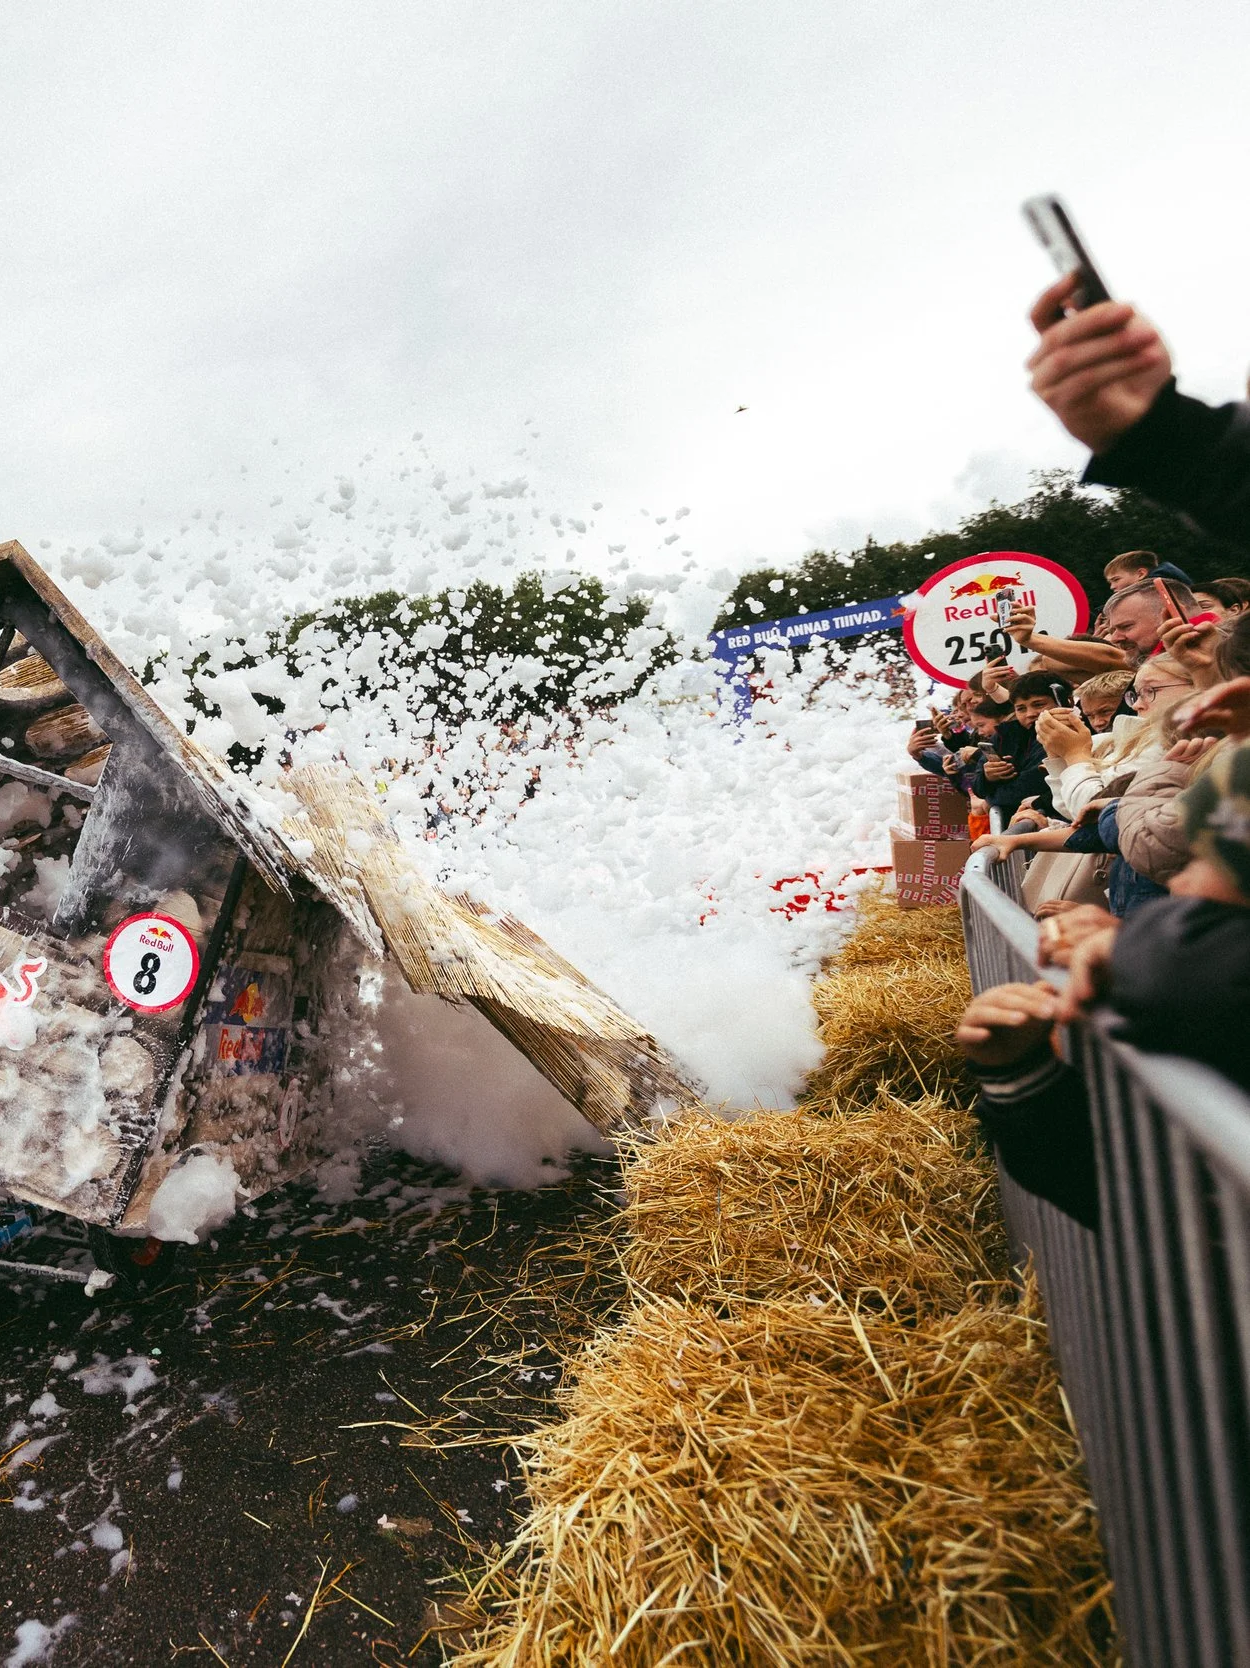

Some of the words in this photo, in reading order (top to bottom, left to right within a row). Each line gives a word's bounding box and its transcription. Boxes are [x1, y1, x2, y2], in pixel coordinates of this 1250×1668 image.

[944, 602, 988, 622] Red
[727, 634, 750, 649] RED
[786, 621, 830, 638] ANNAB
[139, 934, 157, 947] Red
[156, 940, 174, 953] Bull
[133, 952, 161, 995] 8
